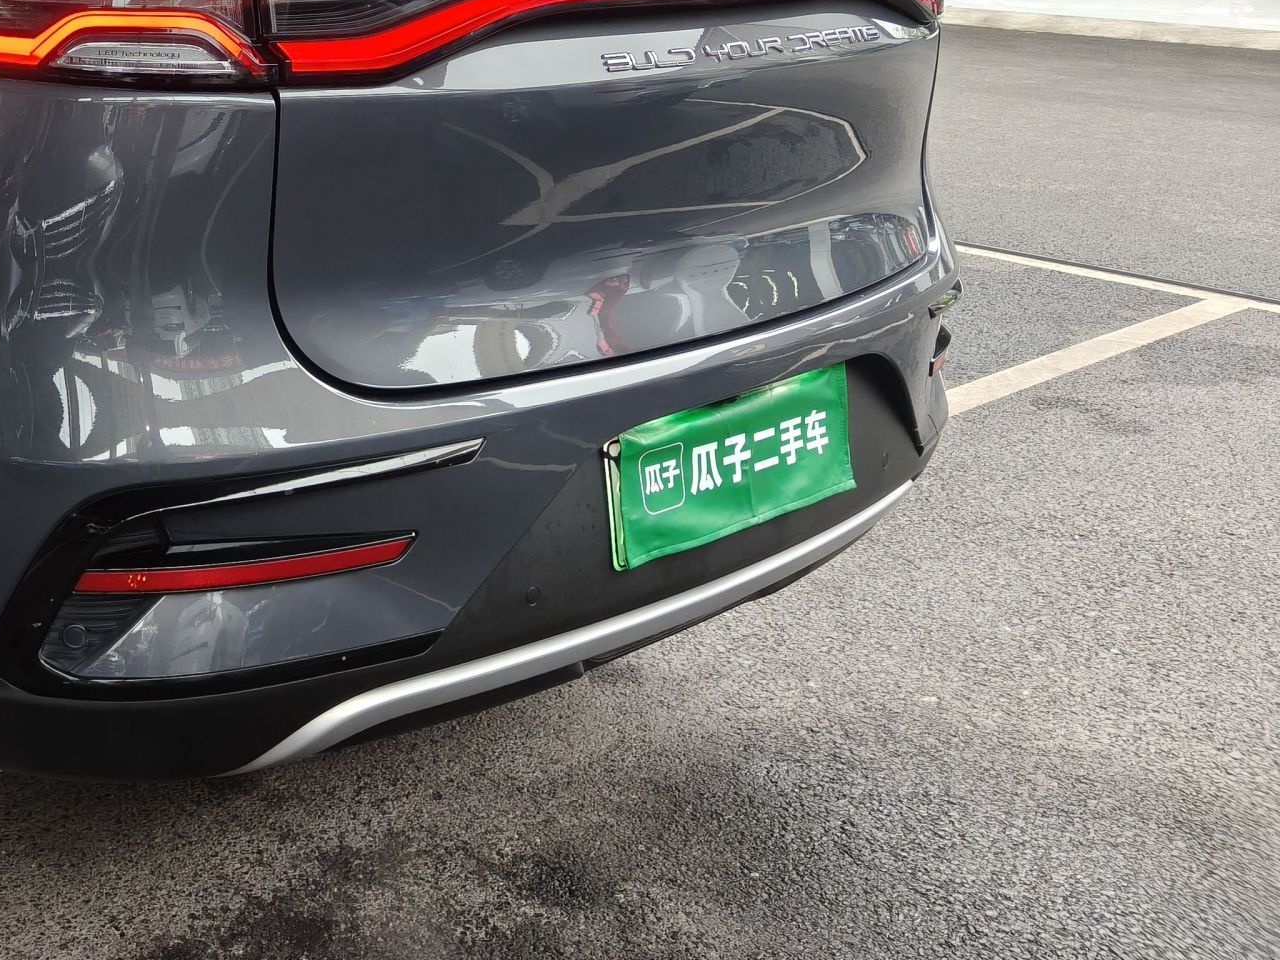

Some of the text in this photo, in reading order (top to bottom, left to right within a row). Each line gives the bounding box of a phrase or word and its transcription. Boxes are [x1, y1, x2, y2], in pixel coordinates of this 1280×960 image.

[121, 50, 181, 60] Technology
[702, 36, 785, 63] YOUR
[785, 25, 881, 53] DREAMS
[644, 408, 830, 496] 瓜子 瓜子二手车
